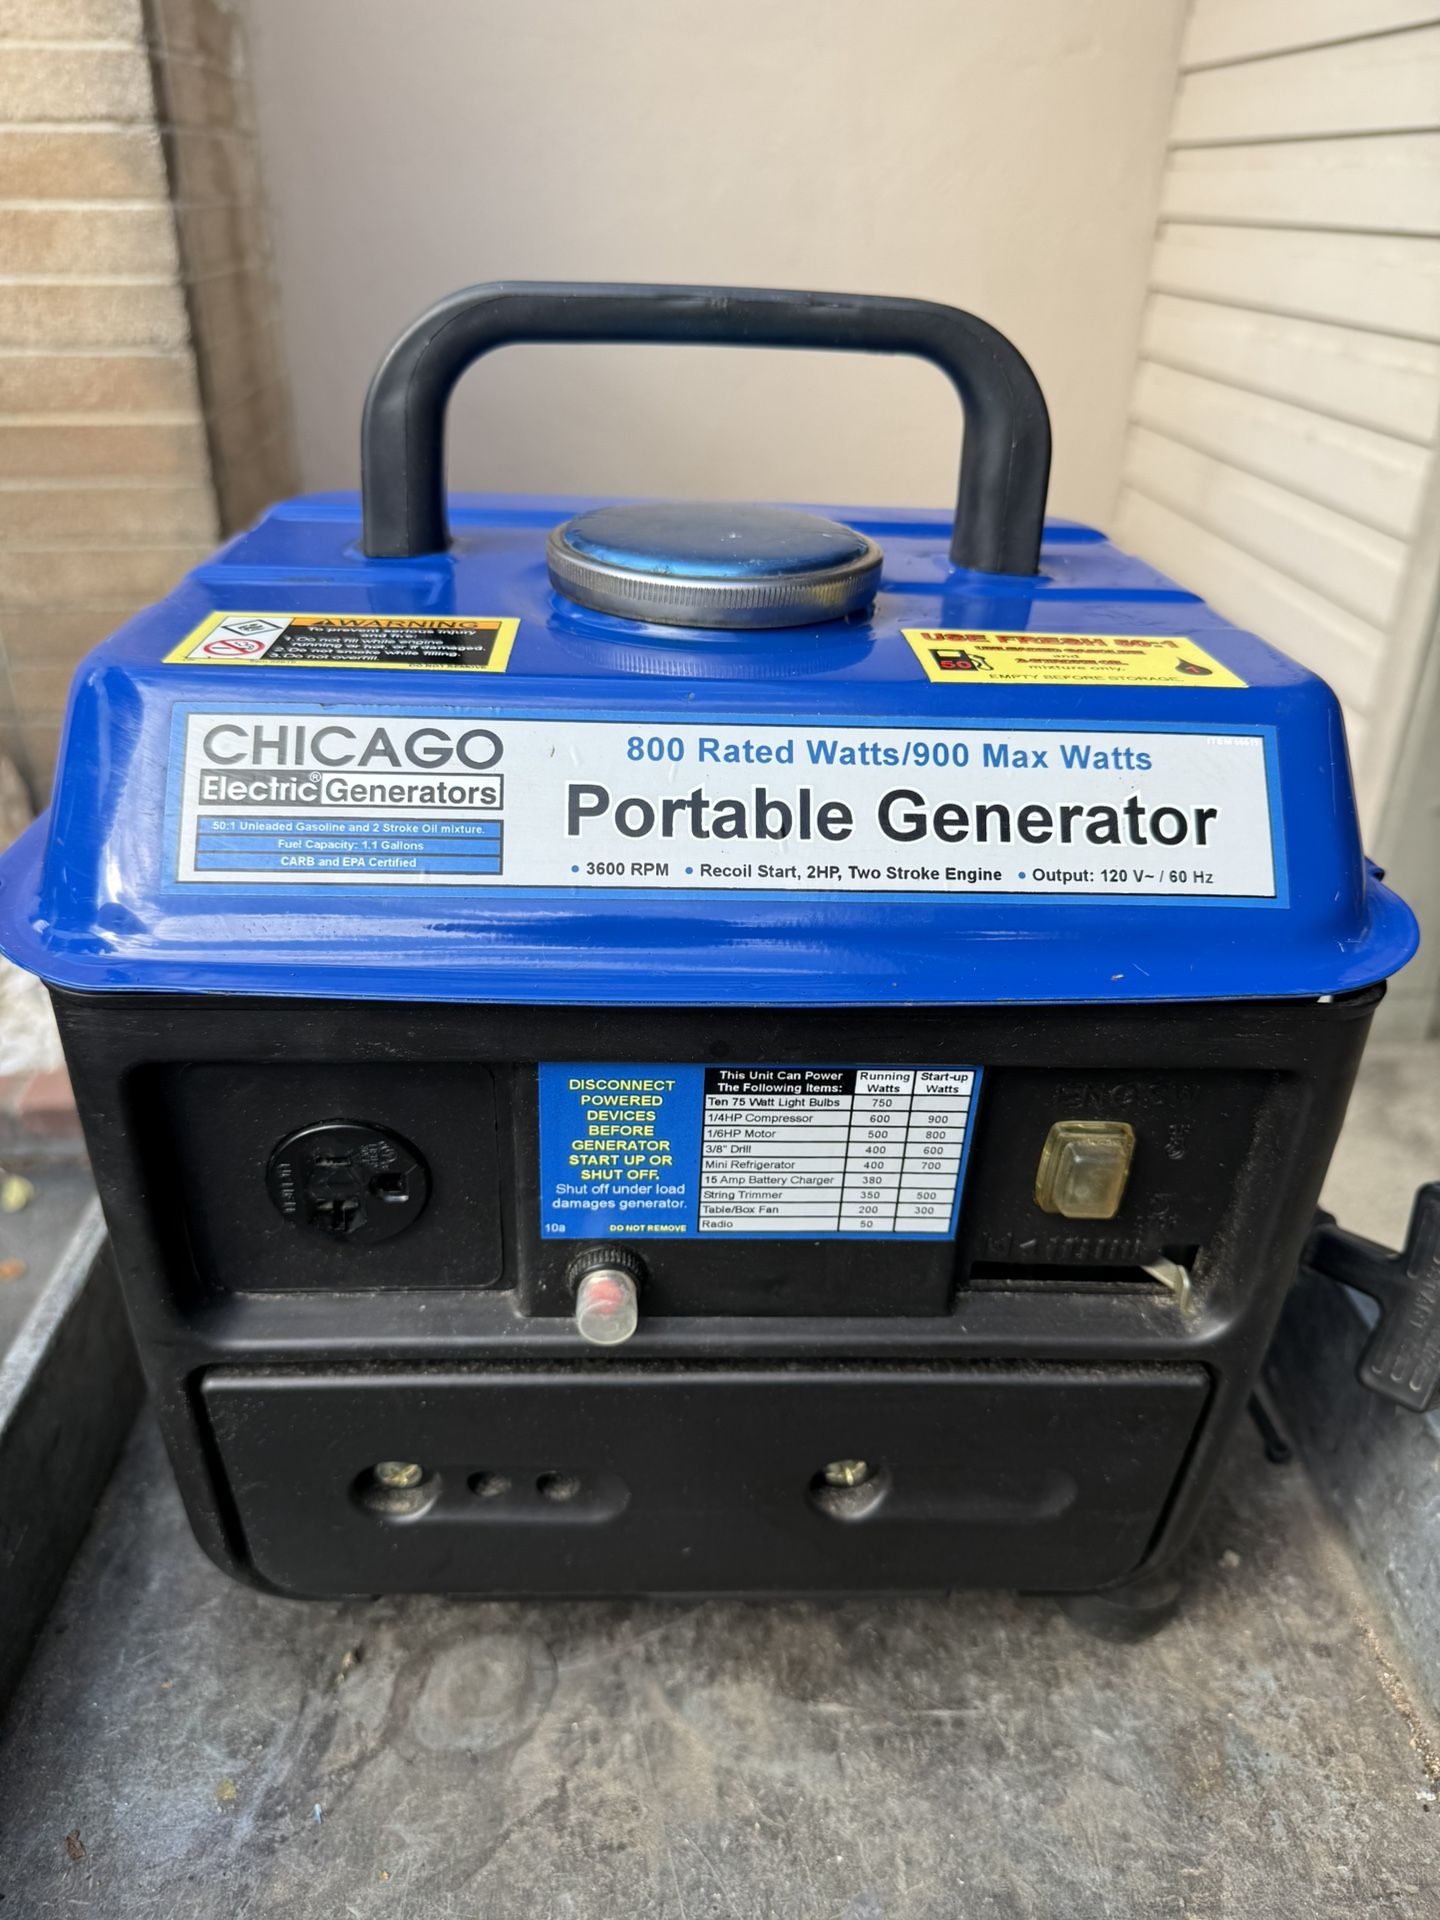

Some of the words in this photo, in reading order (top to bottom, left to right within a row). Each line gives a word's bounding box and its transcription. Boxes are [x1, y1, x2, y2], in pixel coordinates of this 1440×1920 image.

[340, 619, 479, 630] WARNING
[920, 632, 990, 642] USE
[995, 635, 1107, 647] FRESH
[940, 660, 972, 669] 50
[203, 723, 504, 770] CHICAGO
[627, 735, 685, 762] 800
[699, 737, 794, 765] Rated
[806, 740, 969, 767] Watts/900
[982, 743, 1049, 768] Max
[1060, 744, 1153, 771] Watts
[325, 778, 497, 805] Generators
[566, 783, 854, 840] Portable
[877, 788, 1218, 846] Generator
[211, 821, 236, 831] 50:1
[240, 821, 293, 831] Unleaded
[296, 822, 346, 832] Gasoline
[349, 823, 370, 832] and
[373, 823, 381, 833] 2
[383, 823, 420, 833] Stroke
[422, 823, 438, 834] Oil
[441, 823, 485, 834] mixture.
[278, 839, 302, 849] Fuel
[305, 839, 358, 852] Capacity:
[362, 840, 378, 850] 1.1
[381, 840, 424, 851] Gallons
[281, 856, 315, 867] CARB
[319, 857, 339, 867] and
[342, 857, 365, 868] EPA
[368, 857, 417, 868] Certified
[586, 862, 625, 876] 3600
[630, 863, 669, 877] RPM
[700, 864, 752, 878] Recoil
[757, 864, 801, 880] Start,
[806, 865, 842, 881] 2HP,
[848, 865, 881, 879] Two
[886, 866, 940, 880] Stroke
[945, 867, 1002, 884] Engine
[1032, 868, 1094, 885] Output:
[1100, 869, 1128, 883] 120
[1169, 870, 1188, 884] 60
[1193, 871, 1213, 884] Hz
[720, 1070, 747, 1081] This
[749, 1070, 775, 1081] Unit
[777, 1071, 801, 1081] Can
[804, 1071, 843, 1081] Power
[860, 1072, 910, 1083] Running
[921, 1072, 968, 1084] Start-up
[569, 1079, 676, 1092] DISCONNECT
[717, 1083, 740, 1092] The
[743, 1083, 802, 1094] Following
[806, 1083, 843, 1093] Items:
[867, 1084, 901, 1093] Watts
[926, 1085, 959, 1094] Watts
[581, 1095, 663, 1107] POWERED
[708, 1098, 729, 1107] Ten
[732, 1098, 746, 1107] 75
[749, 1098, 775, 1107] Watt
[778, 1098, 805, 1109] Light
[809, 1098, 841, 1107] Bulbs
[872, 1099, 893, 1108] 750
[587, 1110, 656, 1121] DEVICES
[708, 1113, 742, 1123] 1/4HP
[745, 1113, 814, 1125] Compressor
[869, 1114, 890, 1123] 600
[928, 1115, 949, 1124] 900
[589, 1125, 655, 1136] BEFORE
[707, 1129, 741, 1139] 1/6HP
[744, 1129, 776, 1139] Motor
[868, 1130, 888, 1139] 500
[925, 1131, 946, 1140] 800
[571, 1140, 670, 1151] GENERATOR
[705, 1144, 728, 1154] 3/8"
[730, 1145, 752, 1154] Drill
[865, 1146, 886, 1154] 400
[923, 1146, 944, 1155] 600
[569, 1155, 619, 1166] START
[624, 1155, 646, 1166] UP
[650, 1155, 673, 1166] OR
[705, 1160, 728, 1169] Mini
[731, 1160, 796, 1171] Refrigerator
[864, 1161, 884, 1170] 400
[921, 1161, 941, 1170] 700
[581, 1169, 623, 1180] SHUT
[627, 1169, 660, 1180] OFF.
[705, 1175, 717, 1184] 15
[720, 1175, 745, 1186] Amp
[749, 1175, 787, 1187] Battery
[790, 1175, 834, 1187] Charger
[862, 1176, 882, 1185] 380
[555, 1183, 588, 1195] Shut
[591, 1183, 609, 1195] off
[612, 1184, 653, 1195] under
[655, 1184, 686, 1195] load
[703, 1190, 735, 1202] String
[737, 1190, 783, 1200] Trimmer
[860, 1191, 880, 1200] 350
[916, 1191, 937, 1200] 500
[552, 1198, 616, 1211] damages
[619, 1199, 688, 1211] generator.
[703, 1205, 755, 1214] Table/Box
[758, 1205, 779, 1214] Fan
[858, 1205, 878, 1214] 200
[914, 1206, 934, 1215] 300
[544, 1223, 566, 1233] 10a
[609, 1224, 624, 1232] DO
[625, 1224, 646, 1232] NOT
[647, 1224, 687, 1232] REMOVE
[702, 1219, 733, 1228] Radio
[860, 1219, 874, 1228] 50
